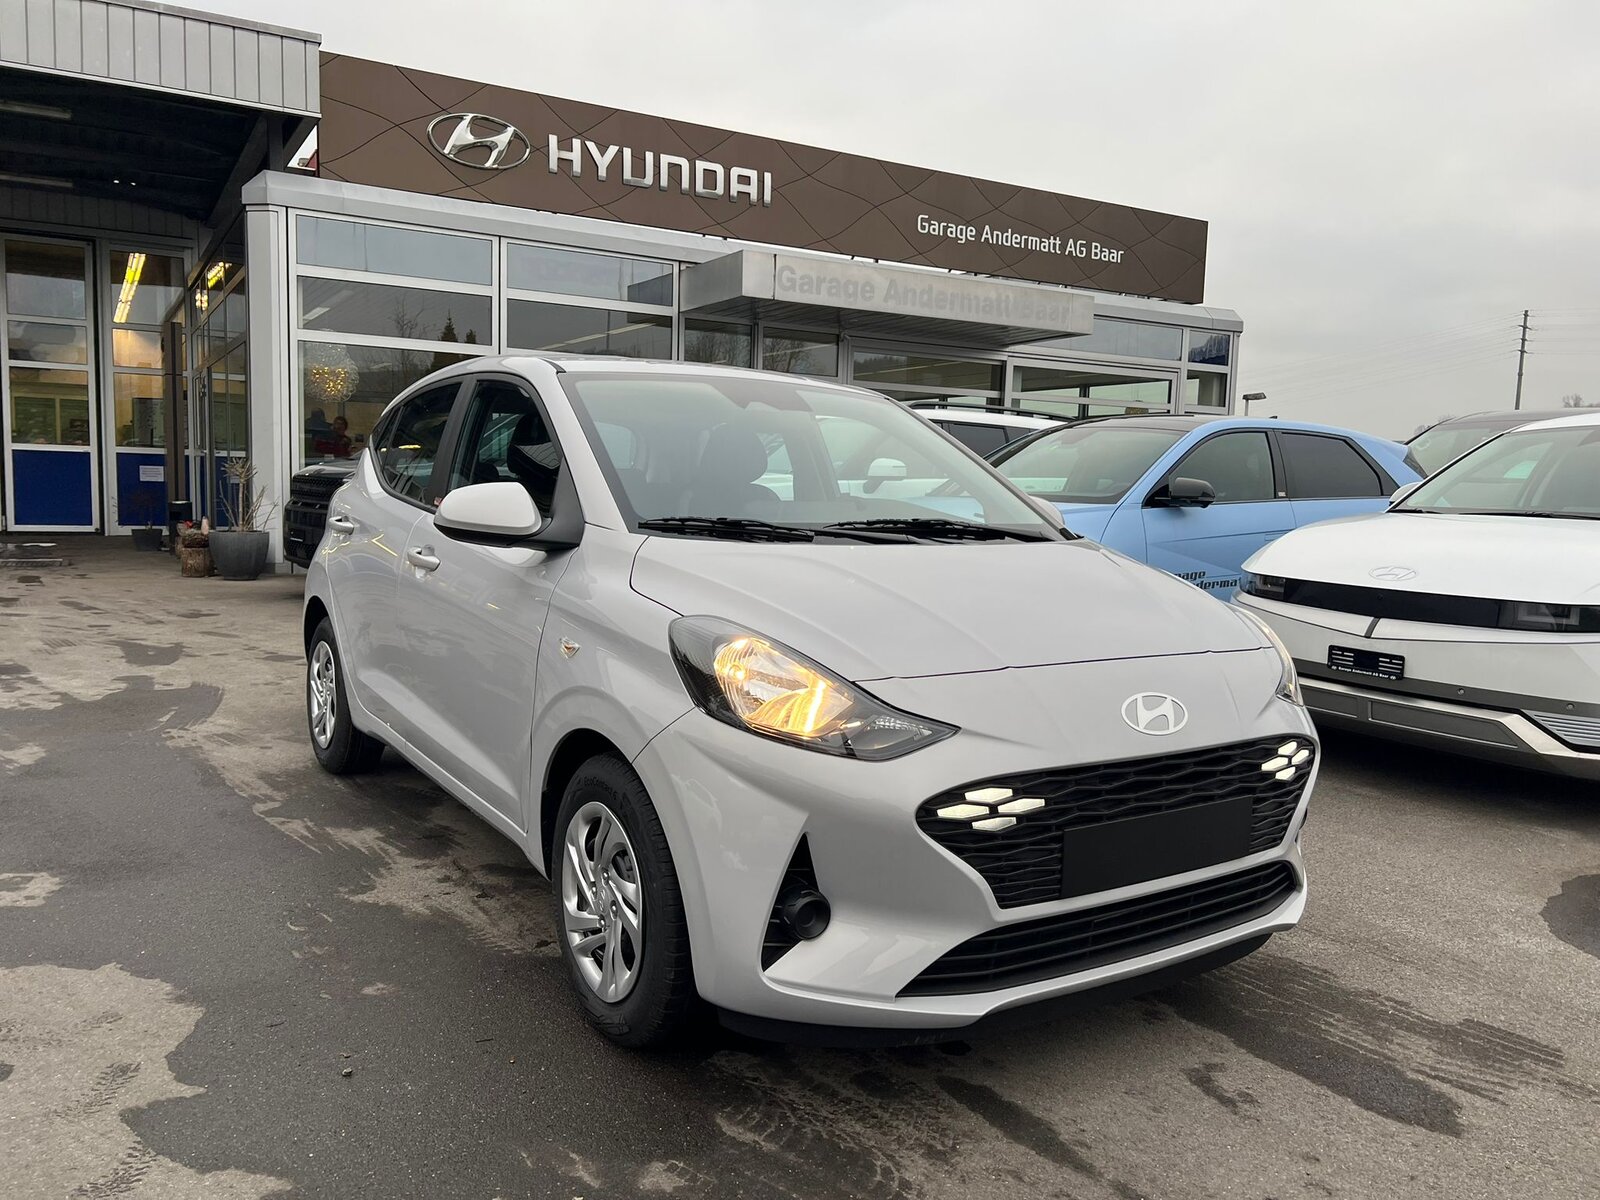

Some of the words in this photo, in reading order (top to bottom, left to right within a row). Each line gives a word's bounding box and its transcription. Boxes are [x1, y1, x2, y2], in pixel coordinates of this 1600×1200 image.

[548, 133, 772, 207] HYUNDAI
[917, 214, 976, 244] Garage
[981, 224, 1062, 255] Andermatt
[1065, 238, 1087, 258] AG
[1091, 242, 1125, 263] Baar
[777, 265, 875, 304] Garage
[883, 278, 1011, 318] Andermatt
